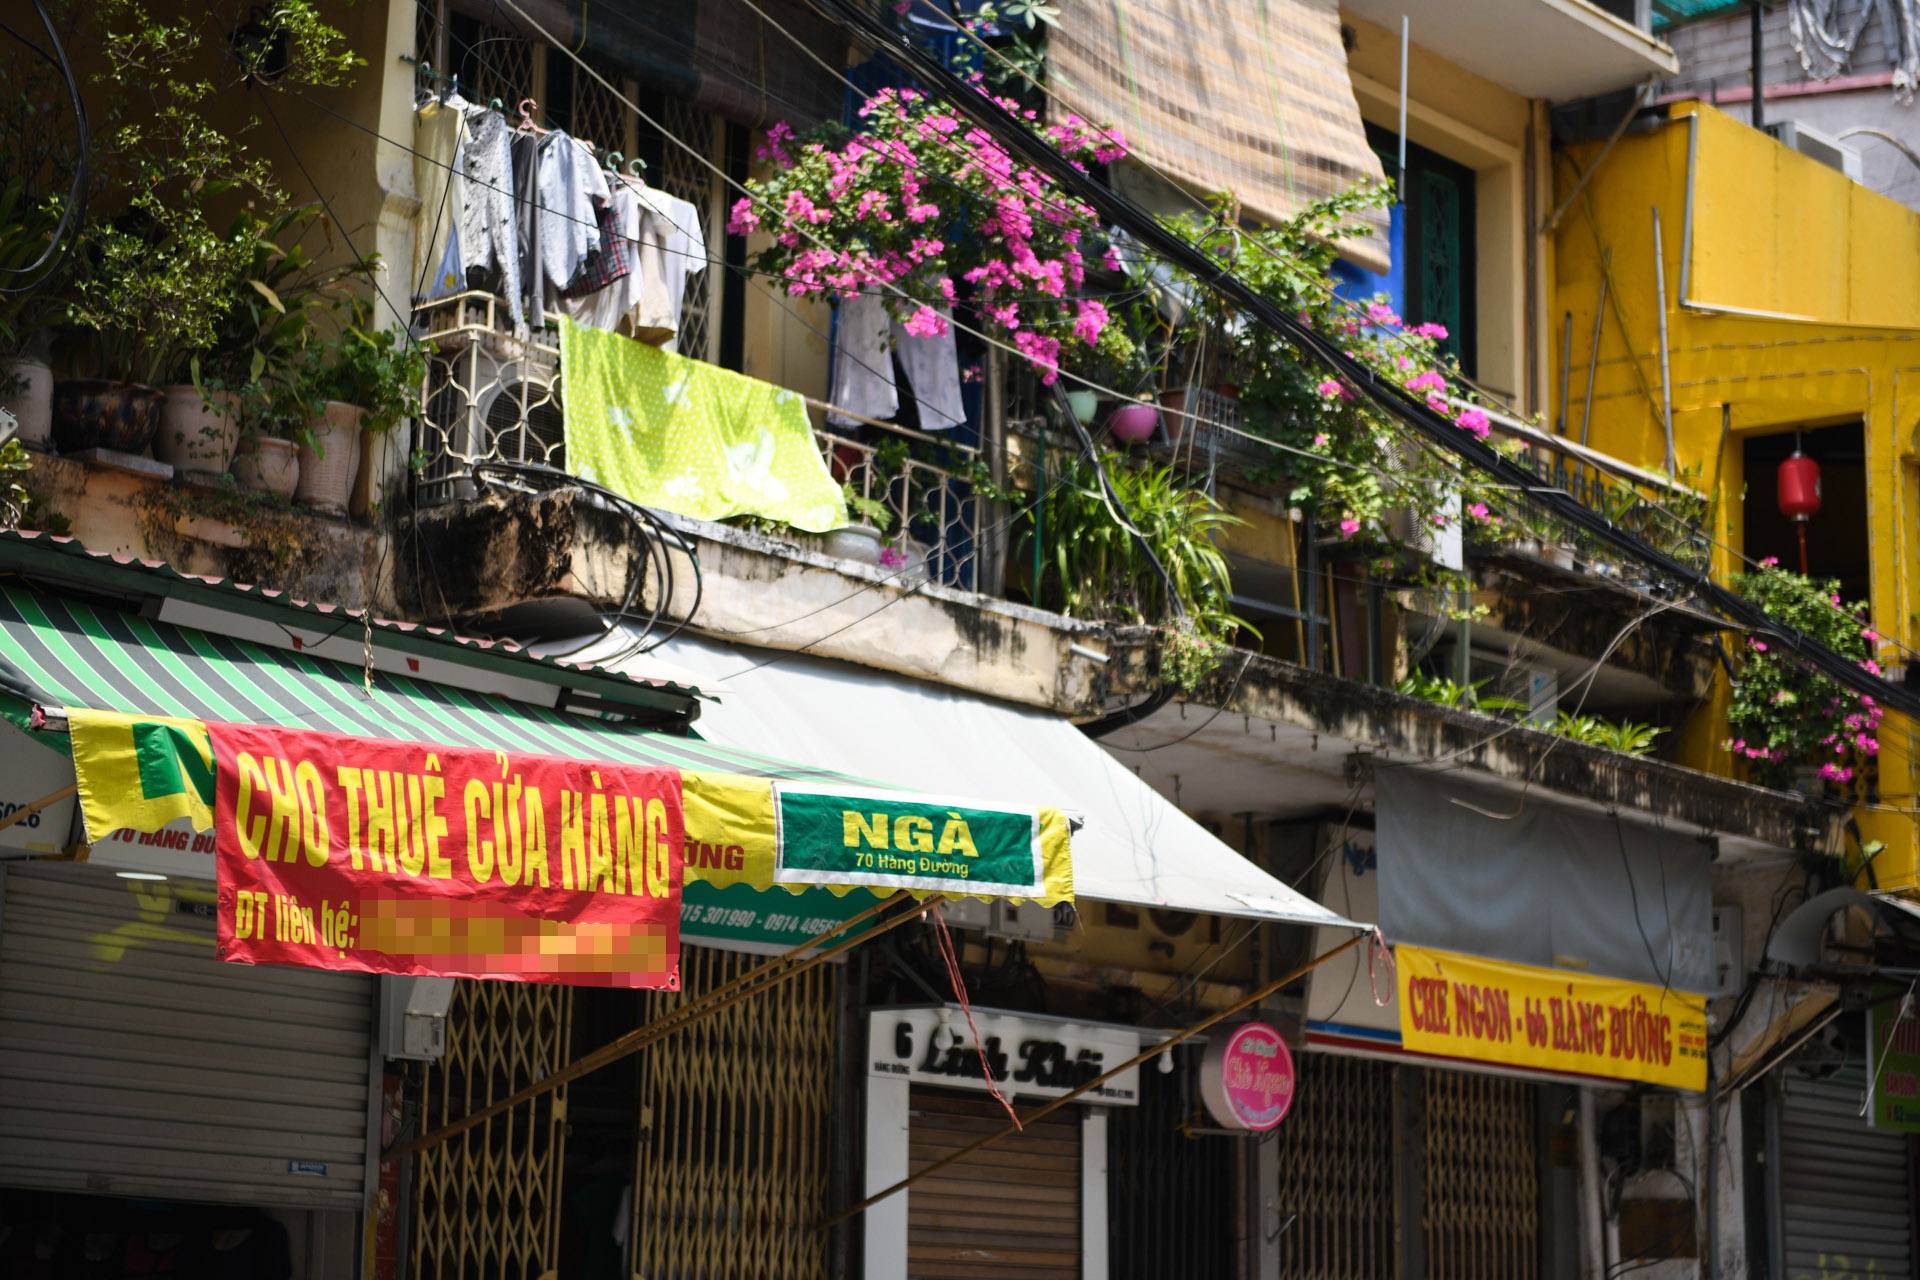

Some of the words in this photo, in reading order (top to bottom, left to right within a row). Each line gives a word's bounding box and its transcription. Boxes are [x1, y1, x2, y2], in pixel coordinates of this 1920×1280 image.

[236, 752, 329, 867] CHO
[337, 753, 452, 879] THUÊ
[464, 750, 550, 889] CỬA
[561, 771, 670, 898] HÀNG
[843, 811, 979, 857] NGÀ
[855, 853, 873, 868] 70
[878, 853, 916, 874] Hàng
[920, 857, 969, 878] Đường
[235, 890, 268, 940] ĐT
[275, 894, 316, 945] liên
[321, 900, 358, 959] hệ:
[702, 906, 757, 928] 301990
[763, 913, 799, 932] 0914
[1409, 962, 1450, 1036] CHÈ
[1453, 982, 1512, 1043] NGON
[895, 1022, 914, 1059] 6
